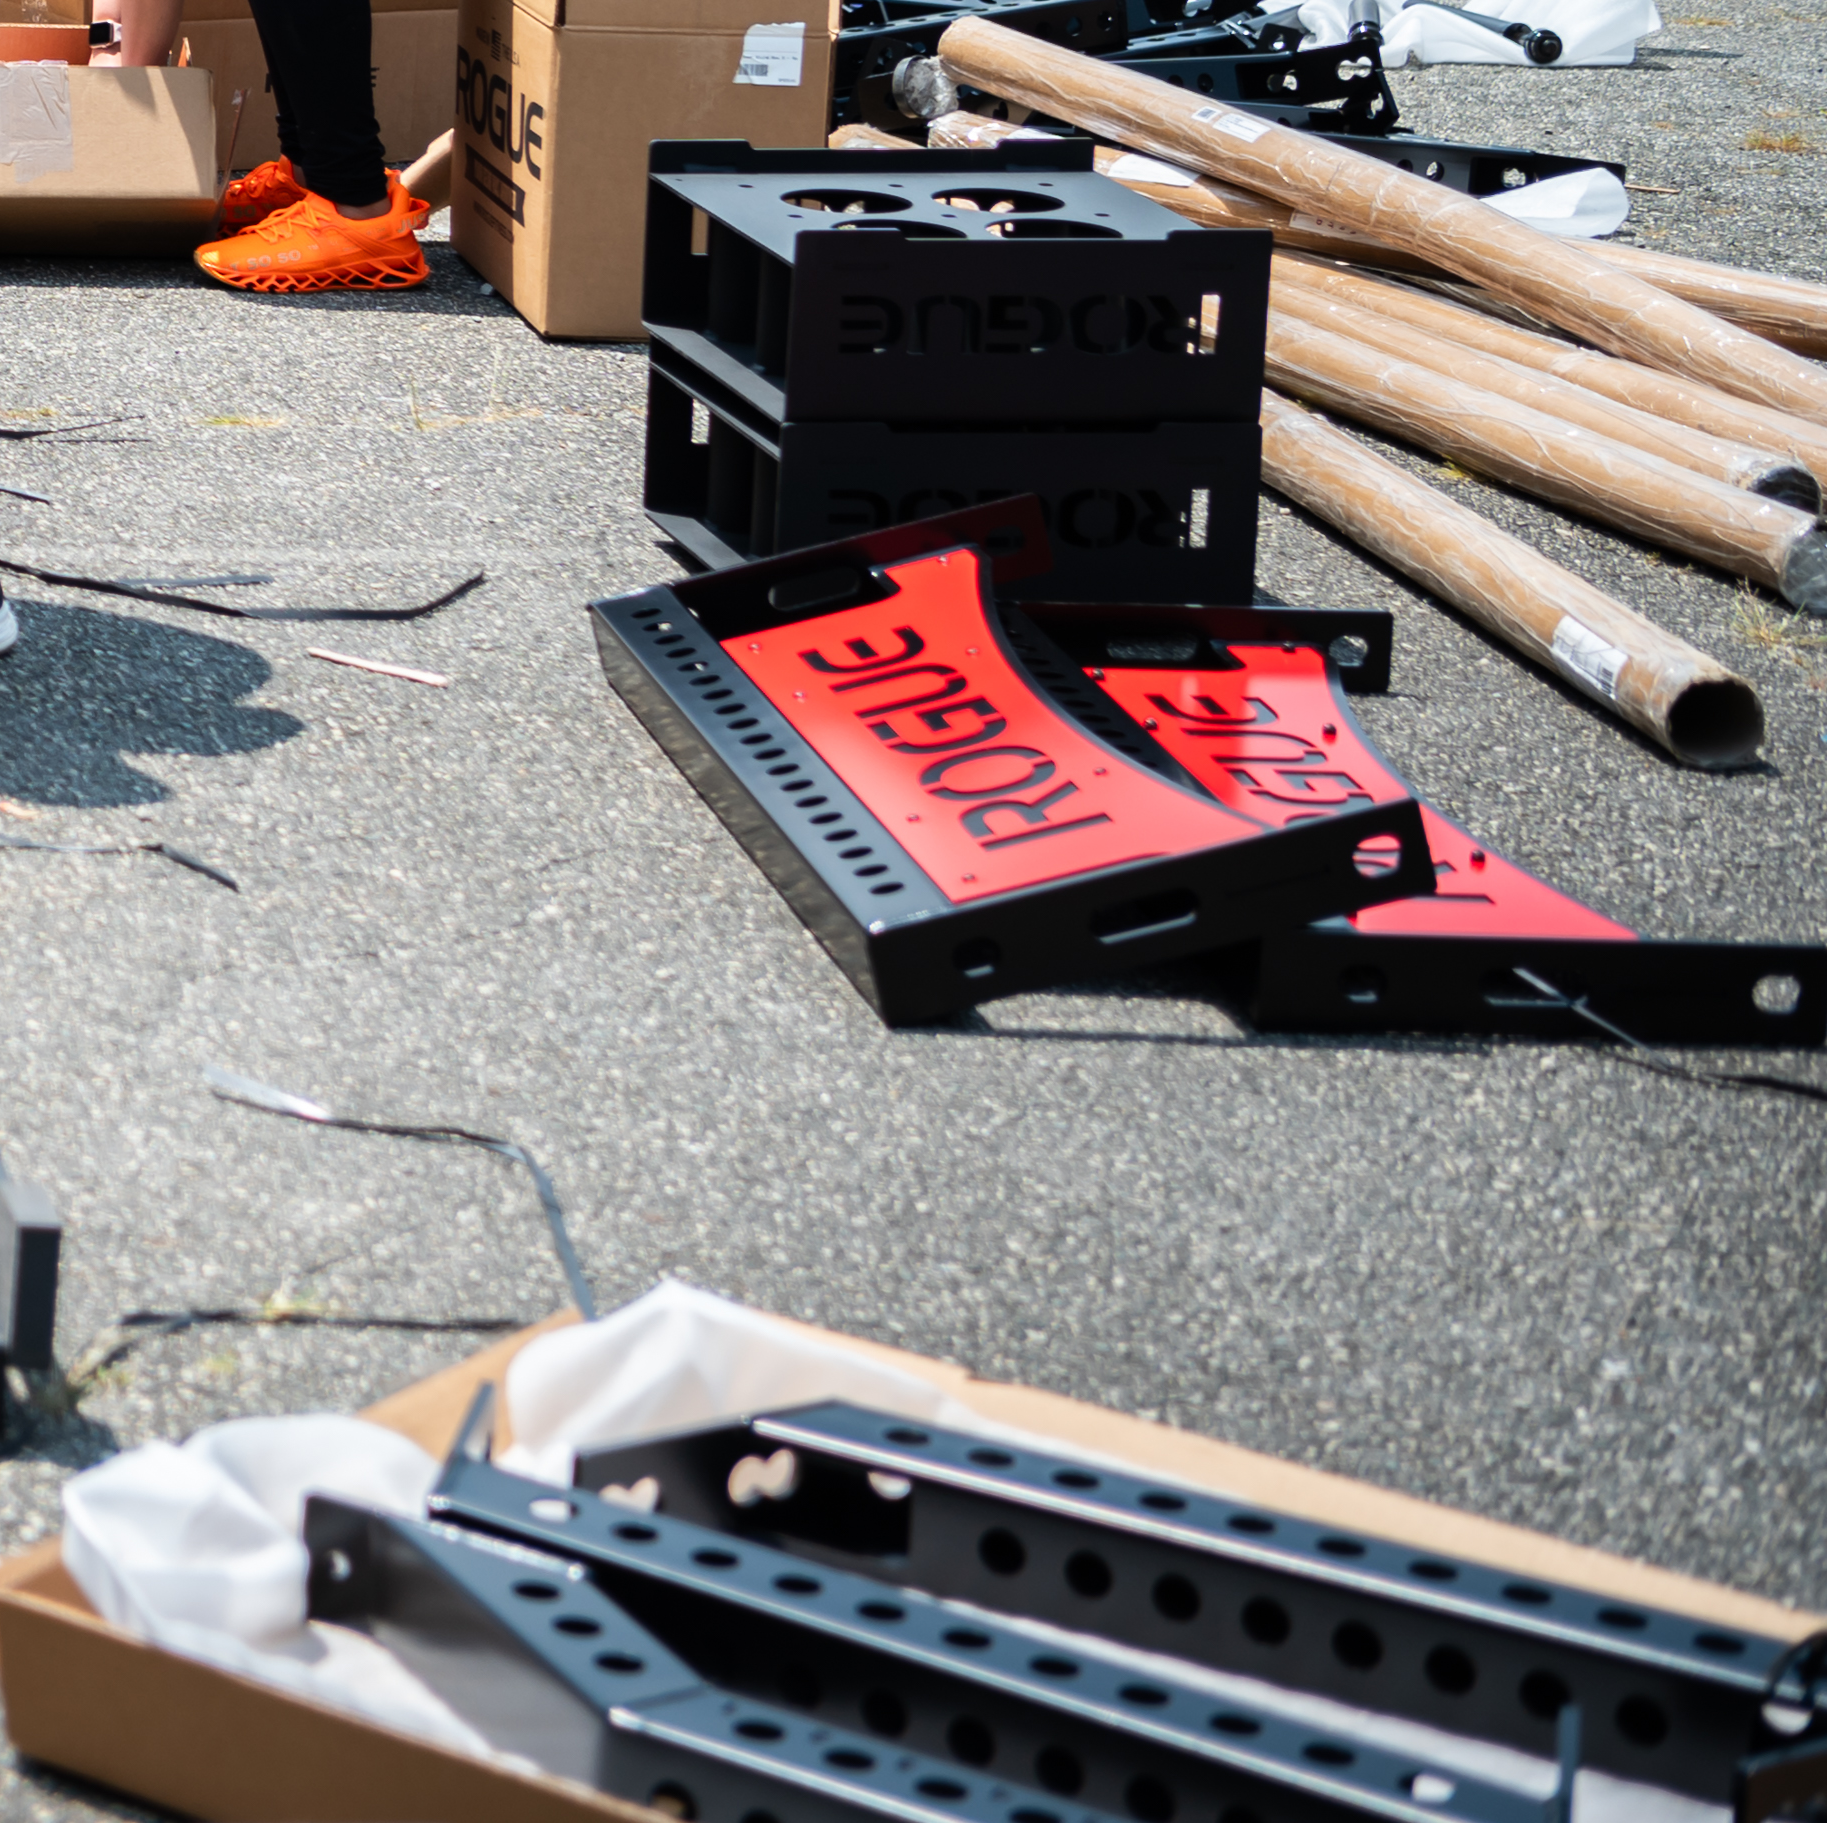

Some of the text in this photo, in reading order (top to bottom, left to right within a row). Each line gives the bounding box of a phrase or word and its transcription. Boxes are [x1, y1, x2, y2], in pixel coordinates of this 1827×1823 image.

[456, 45, 545, 181] ROGUE
[248, 249, 301, 271] SO SO
[838, 293, 1222, 356] ROGUE
[797, 625, 1114, 851] ROGUE
